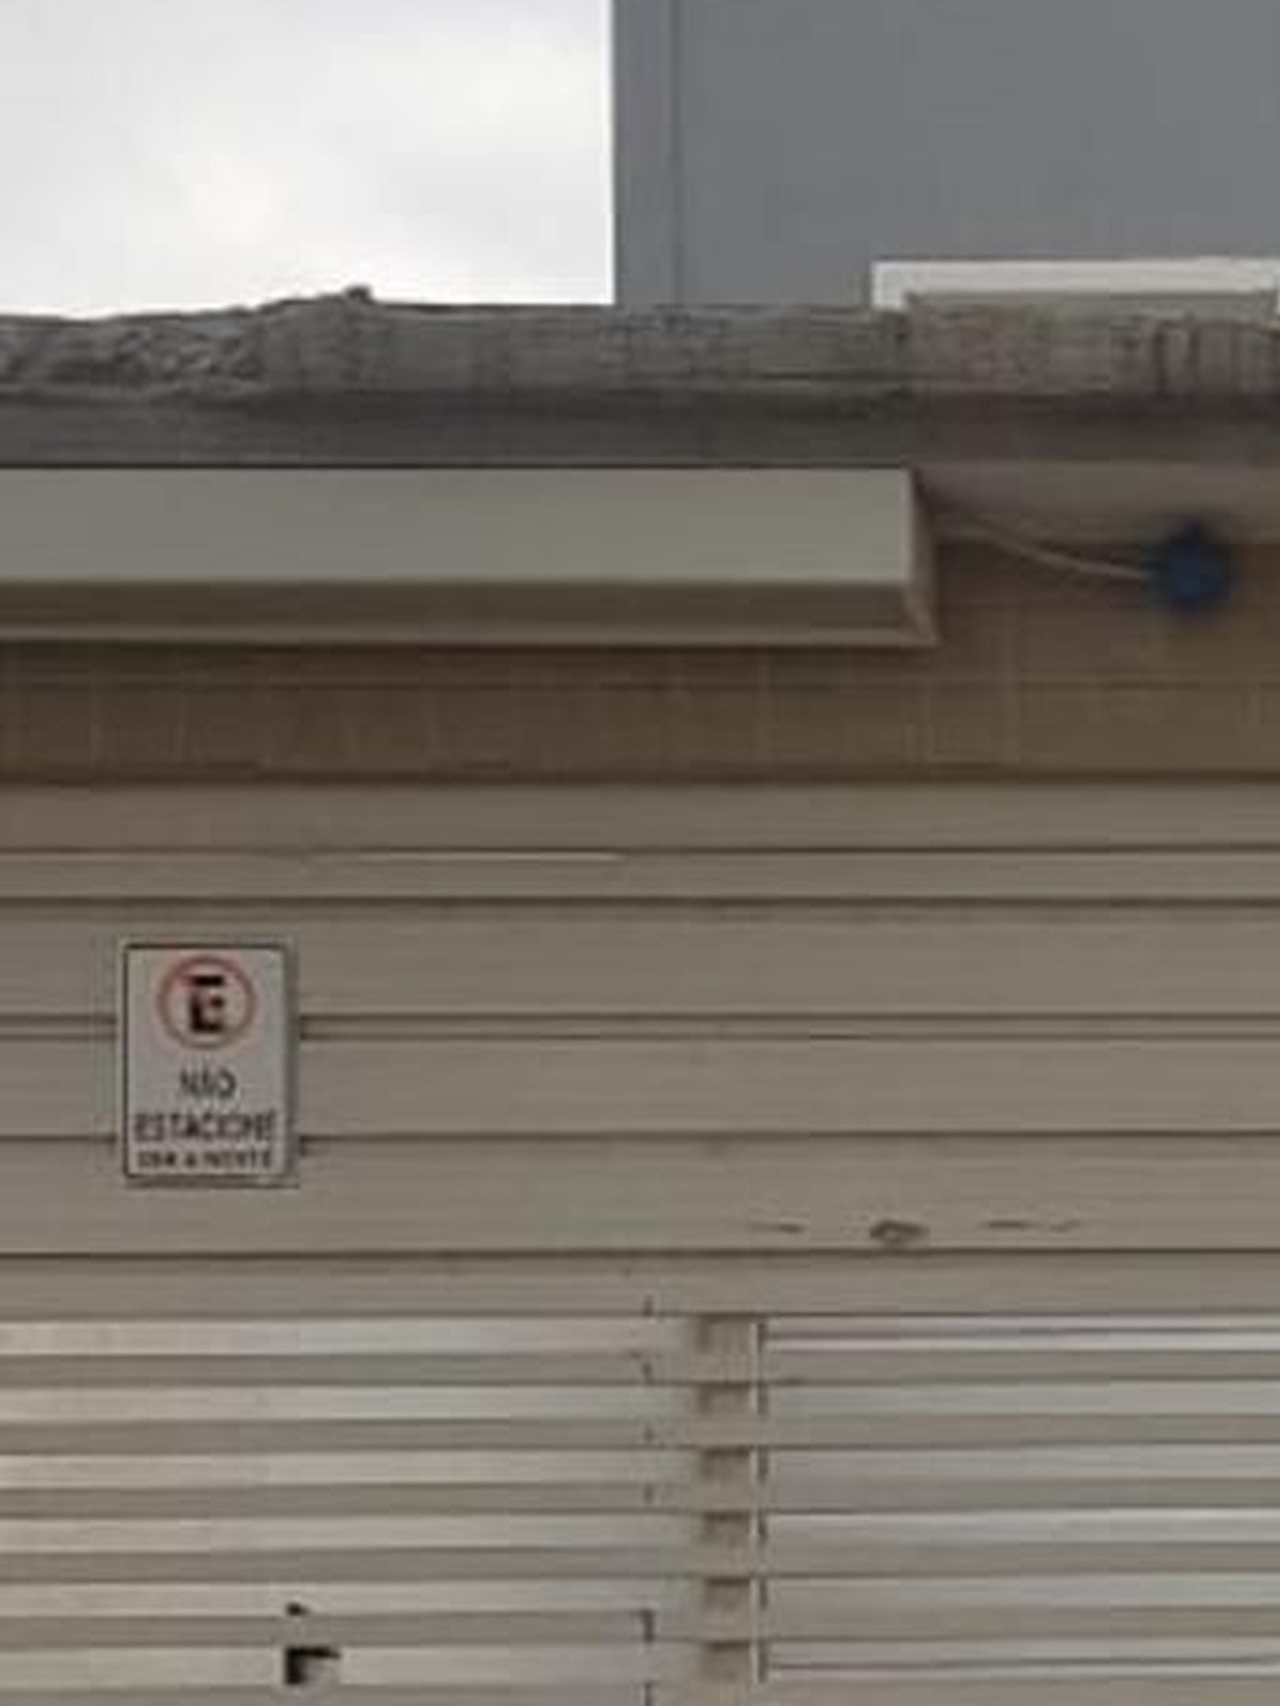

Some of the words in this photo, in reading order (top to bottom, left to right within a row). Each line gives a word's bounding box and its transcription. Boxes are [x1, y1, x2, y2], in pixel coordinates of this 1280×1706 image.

[189, 974, 226, 1034] E
[179, 1062, 237, 1099] NÃO
[134, 1111, 275, 1142] ESTACIONE
